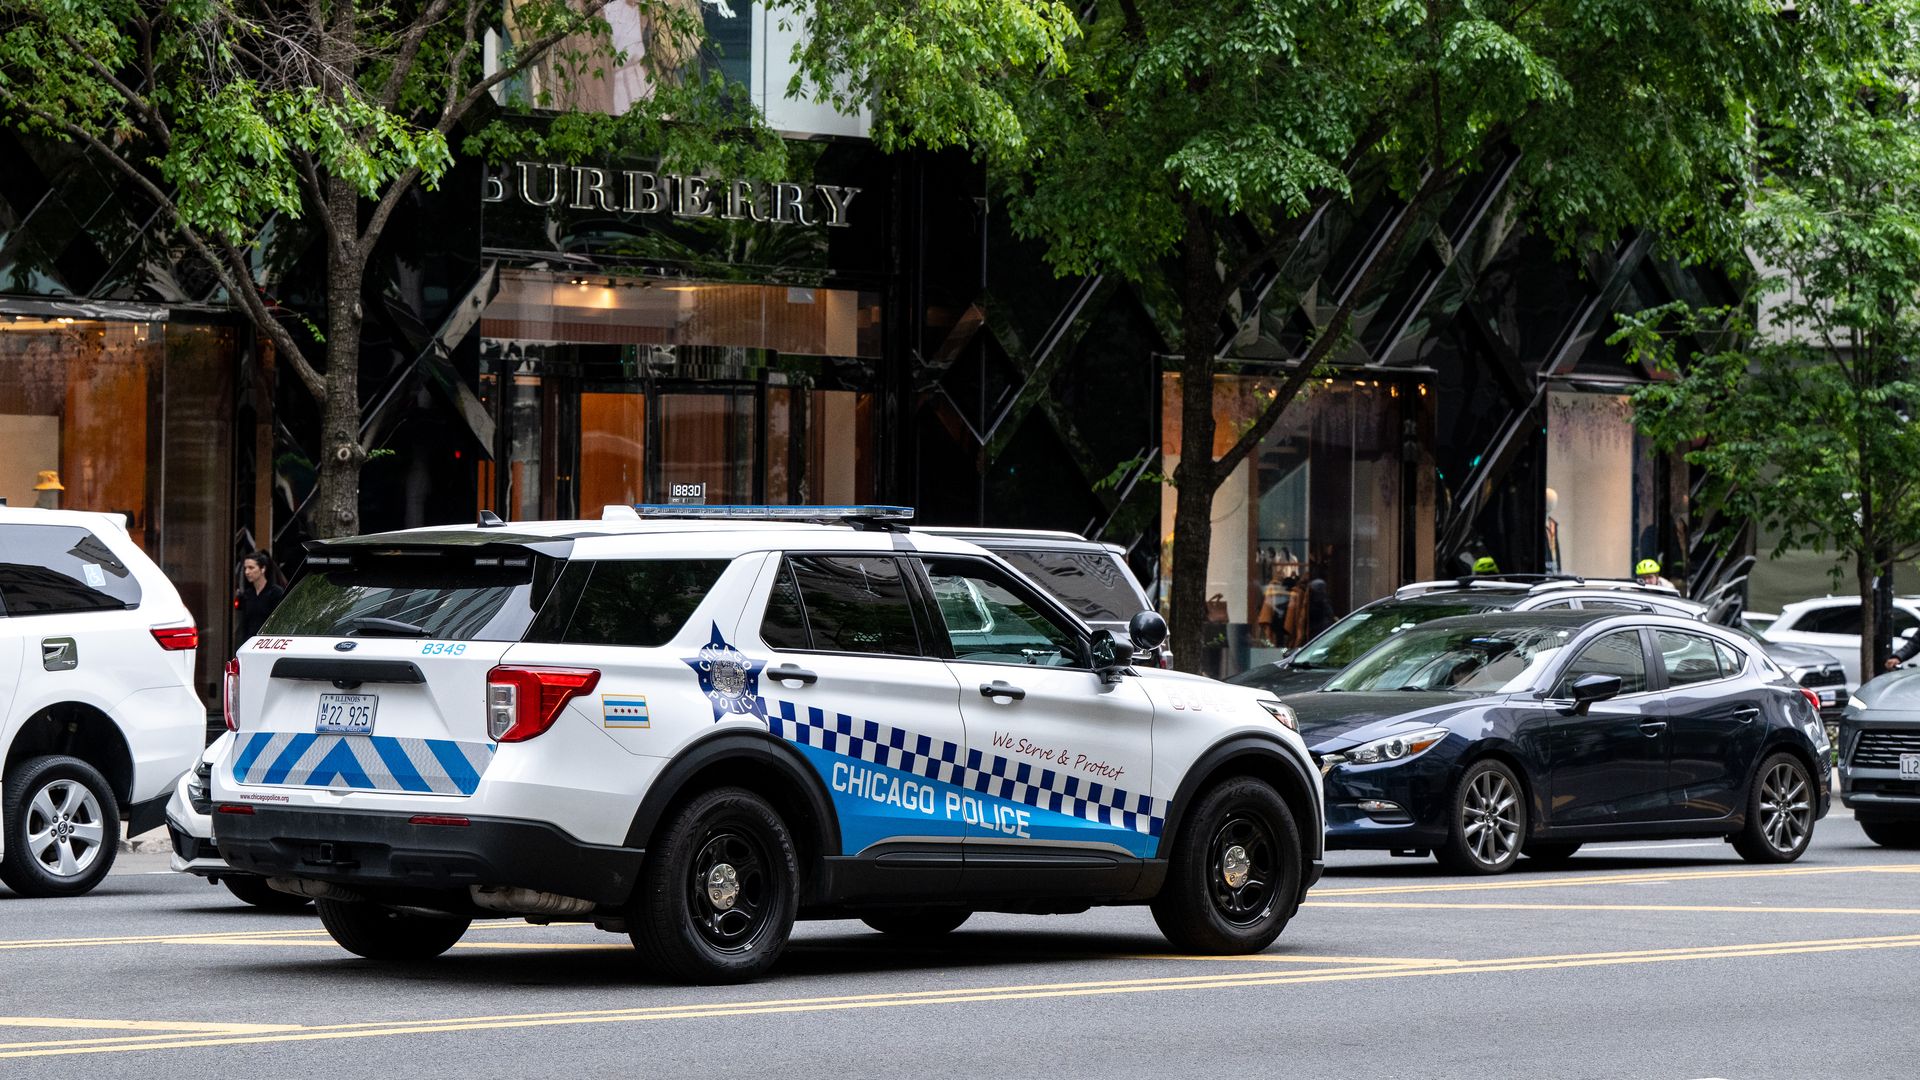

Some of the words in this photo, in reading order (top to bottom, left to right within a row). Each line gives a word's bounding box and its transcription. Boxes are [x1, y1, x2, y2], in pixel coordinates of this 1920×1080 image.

[482, 161, 862, 227] BURBERRY
[252, 638, 293, 650] POLICE
[421, 643, 467, 656] 8349
[699, 643, 753, 672] CHICAGO
[708, 690, 758, 714] POLICE
[329, 706, 343, 725] 22
[349, 706, 369, 725] 925
[992, 731, 1014, 749] We
[1015, 738, 1055, 761] Serve
[1057, 749, 1070, 764] &
[1073, 754, 1125, 781] Protect
[832, 762, 934, 815] CHICAGO
[946, 792, 1031, 839] POLICE
